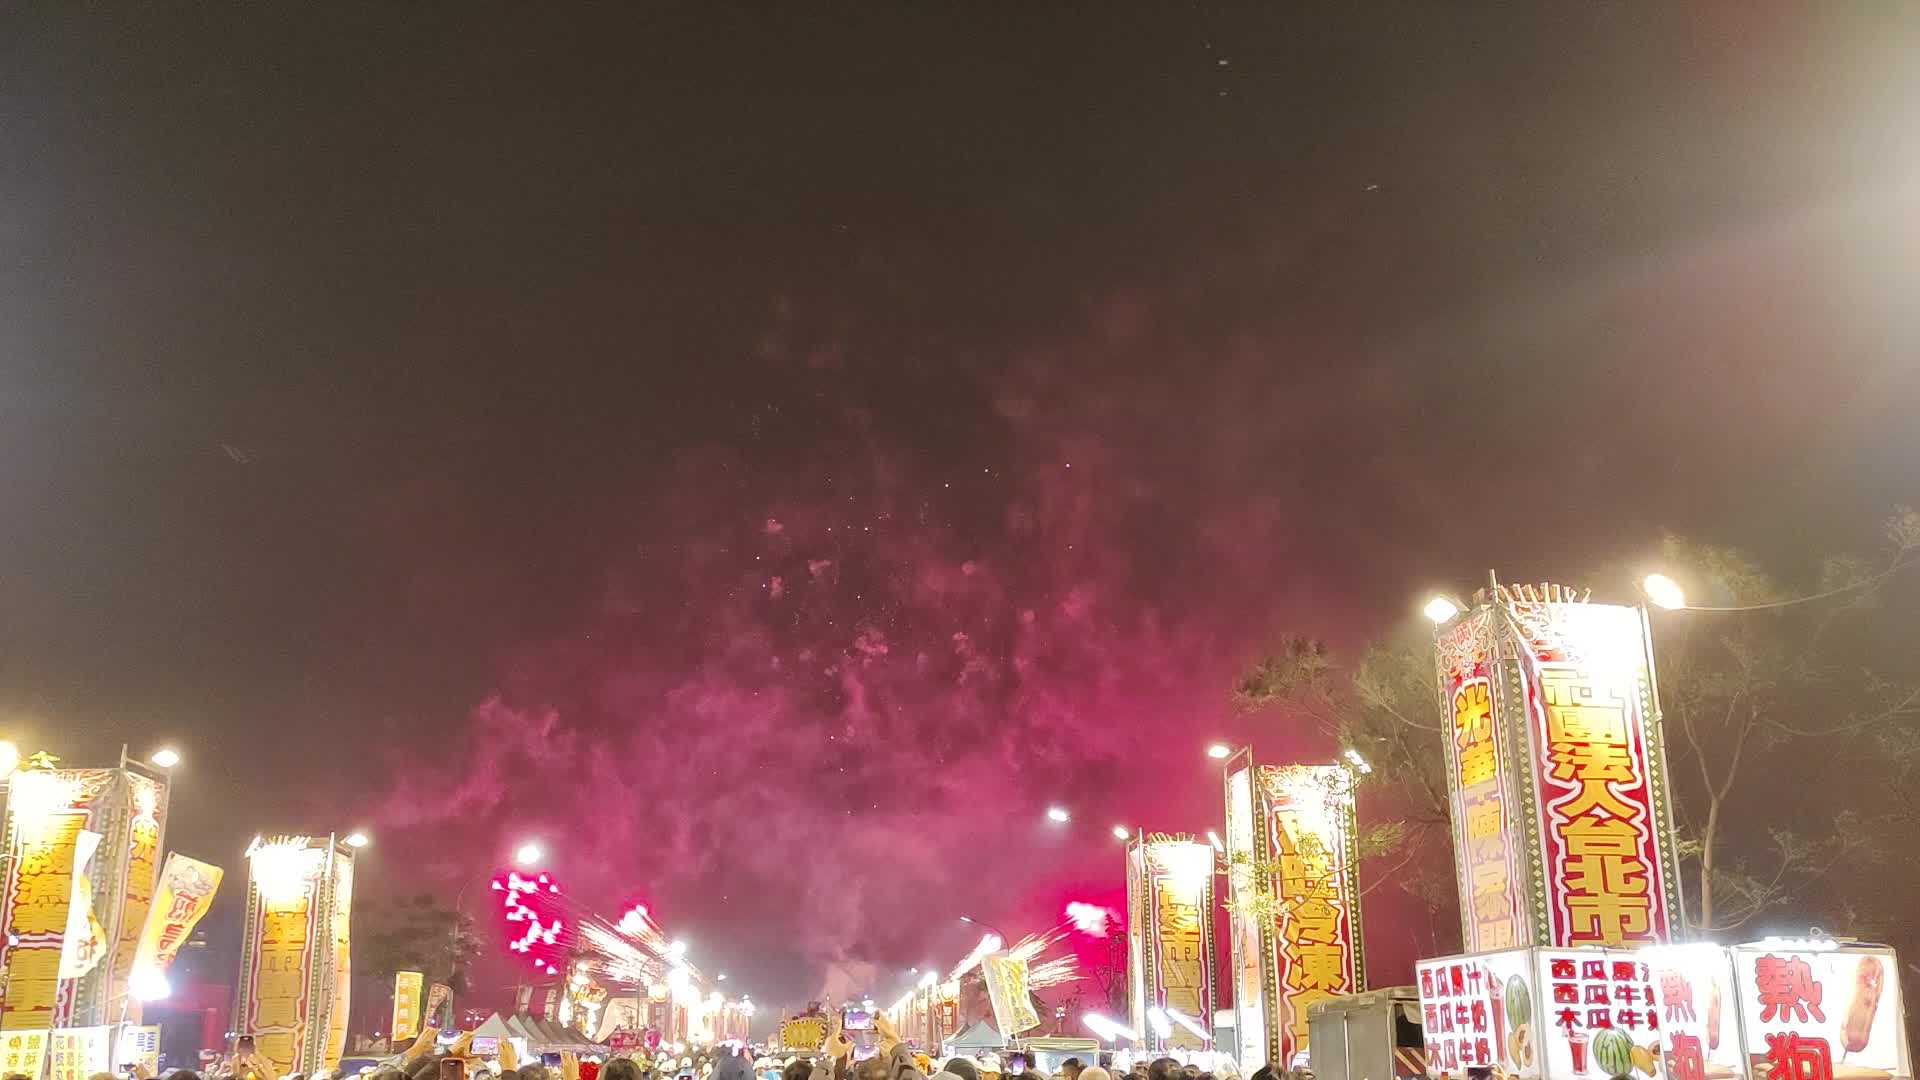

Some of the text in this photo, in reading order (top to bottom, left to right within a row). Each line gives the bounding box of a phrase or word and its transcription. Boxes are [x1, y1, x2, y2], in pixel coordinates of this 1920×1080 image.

[1423, 999, 1488, 1033] 西瓜牛奶
[1755, 953, 1834, 1080] 熱狗
[1426, 1037, 1491, 1070] 木瓜牛奶
